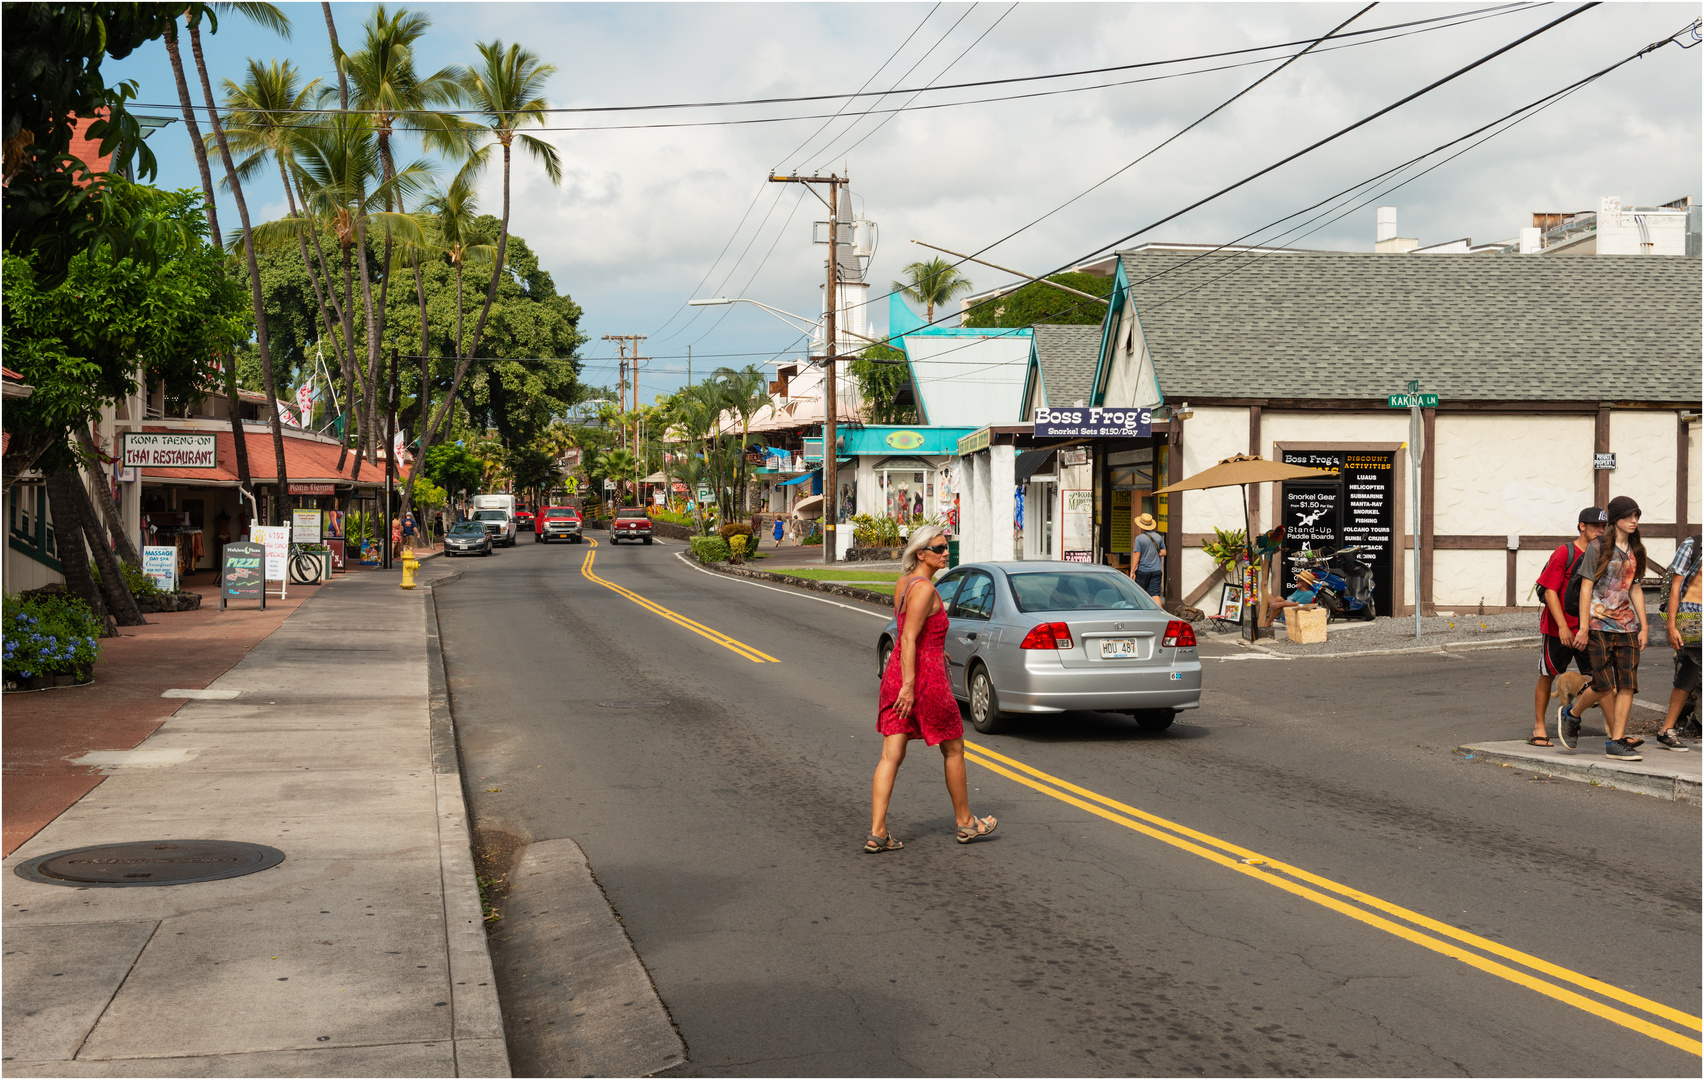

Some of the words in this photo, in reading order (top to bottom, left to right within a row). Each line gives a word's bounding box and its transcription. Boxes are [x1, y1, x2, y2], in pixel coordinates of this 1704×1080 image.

[1391, 396, 1424, 406] KAKINA
[1427, 396, 1436, 404] LN
[1035, 408, 1082, 424] Boss
[1089, 408, 1151, 429] Frog's
[1048, 427, 1079, 435] Snorkel
[1081, 427, 1098, 435] Sets
[130, 436, 158, 445] KONA
[162, 436, 211, 445] TAENG-ON
[127, 448, 150, 464] THAI
[152, 448, 214, 465] RESTAURANT
[1285, 454, 1307, 463] Boss
[1288, 526, 1332, 534] Stand-Up
[226, 557, 260, 568] PIZZA
[1065, 555, 1092, 563] TATTOO
[1102, 643, 1117, 653] HDU
[1122, 643, 1135, 653] 487
